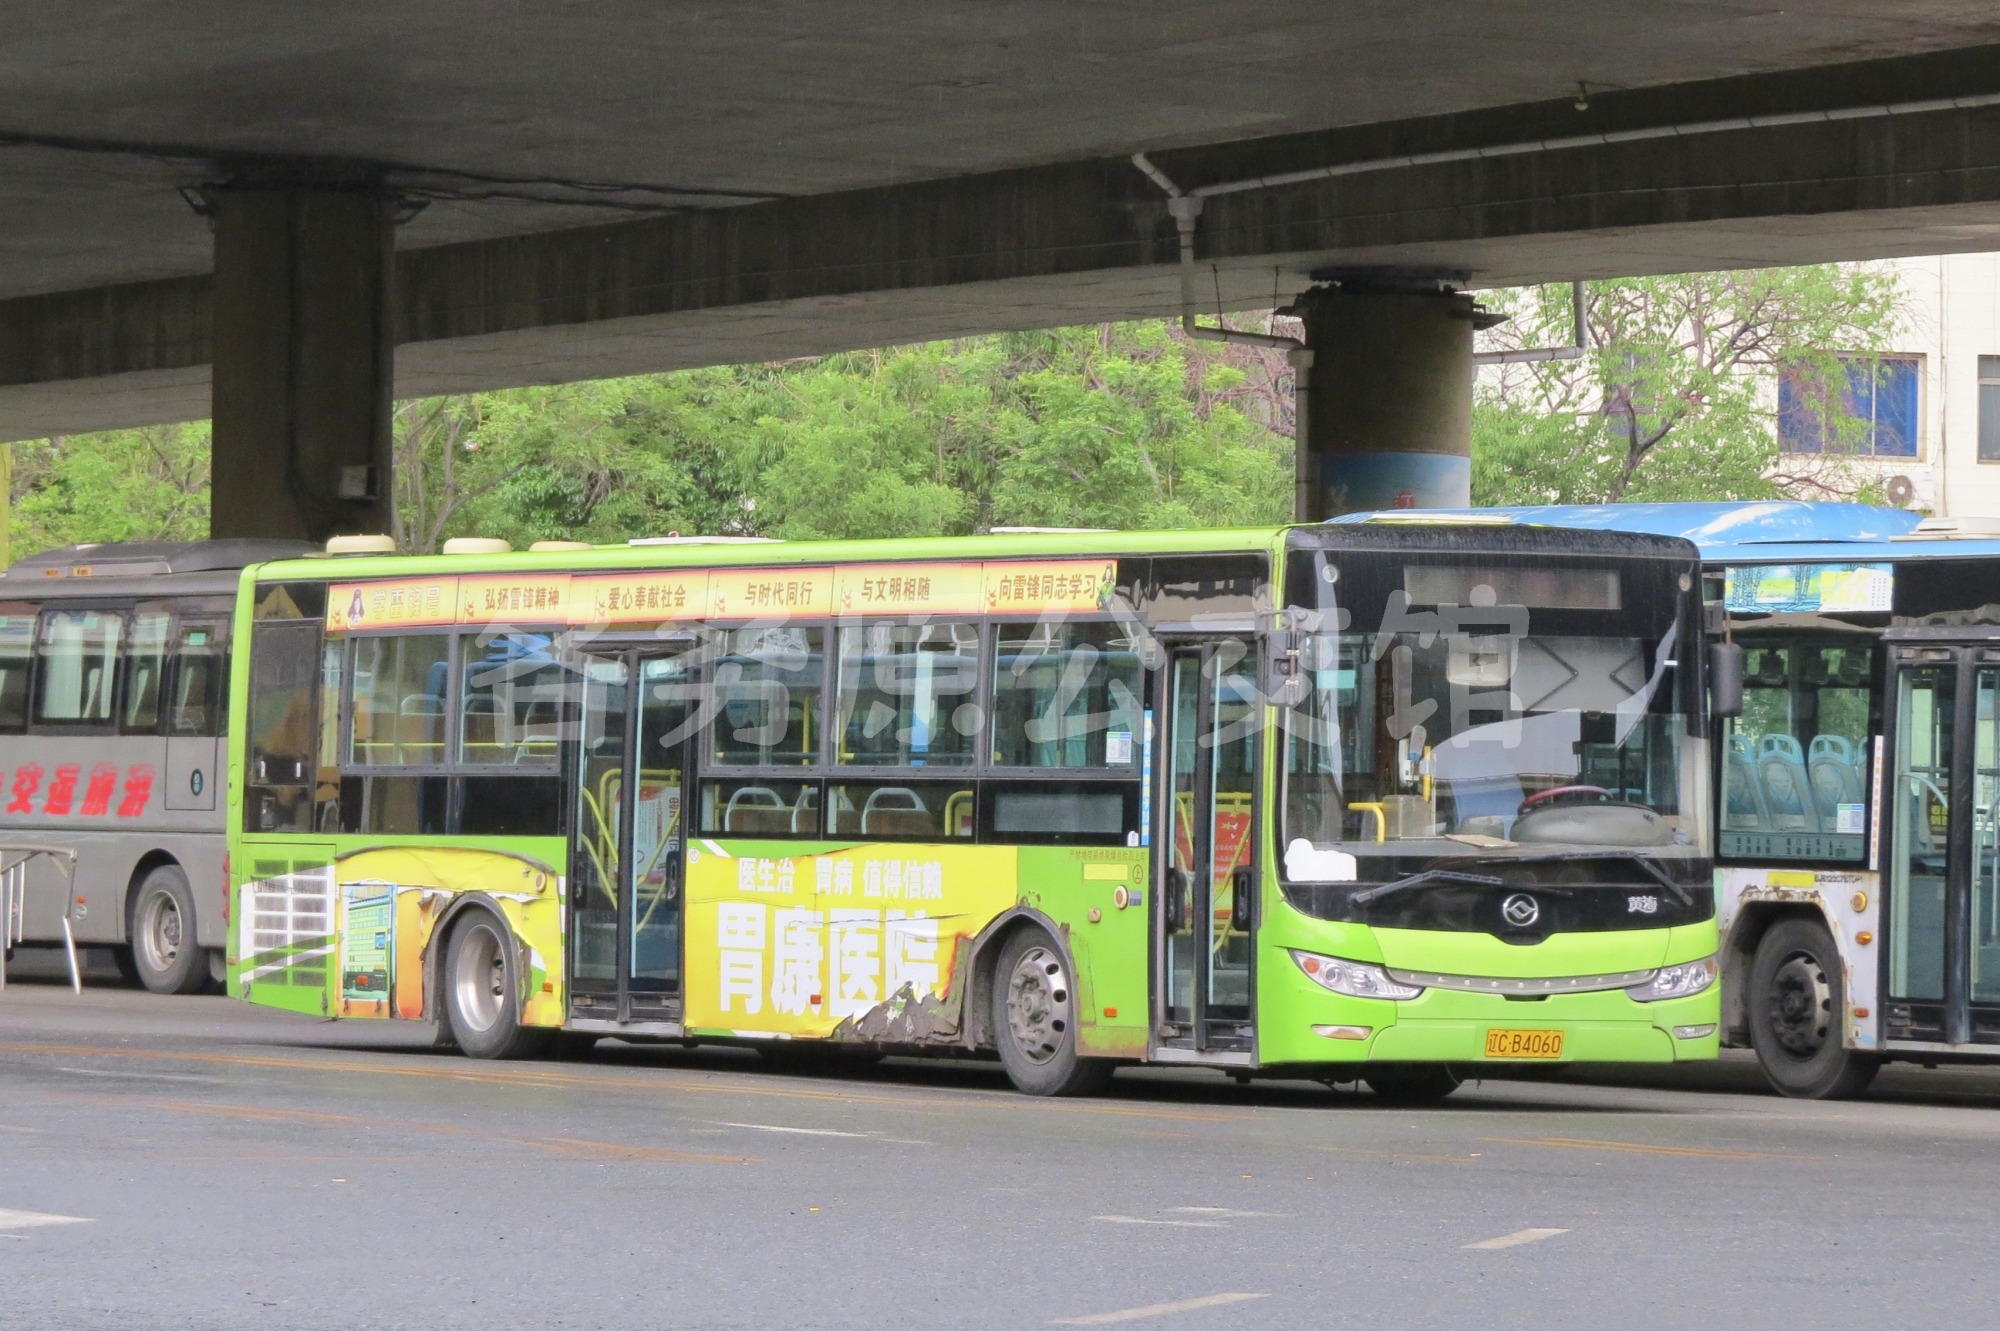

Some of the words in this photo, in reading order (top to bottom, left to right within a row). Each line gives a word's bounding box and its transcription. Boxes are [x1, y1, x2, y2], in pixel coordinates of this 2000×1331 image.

[485, 586, 560, 611] 弘扬雷锋精神
[608, 584, 687, 611] 爱心奉献社会
[745, 581, 813, 606] 与时代同行
[861, 577, 931, 602] 与文明相随
[999, 574, 1097, 600] 向雷锋同志学习
[373, 586, 440, 619] 学雷锋号
[0, 761, 155, 817] 交运旅游
[738, 857, 795, 893] 医生治
[815, 857, 853, 896] 胃病
[863, 860, 943, 898] 值得信赖
[1627, 896, 1658, 913] 黄海
[718, 902, 939, 1018] 胃康医院
